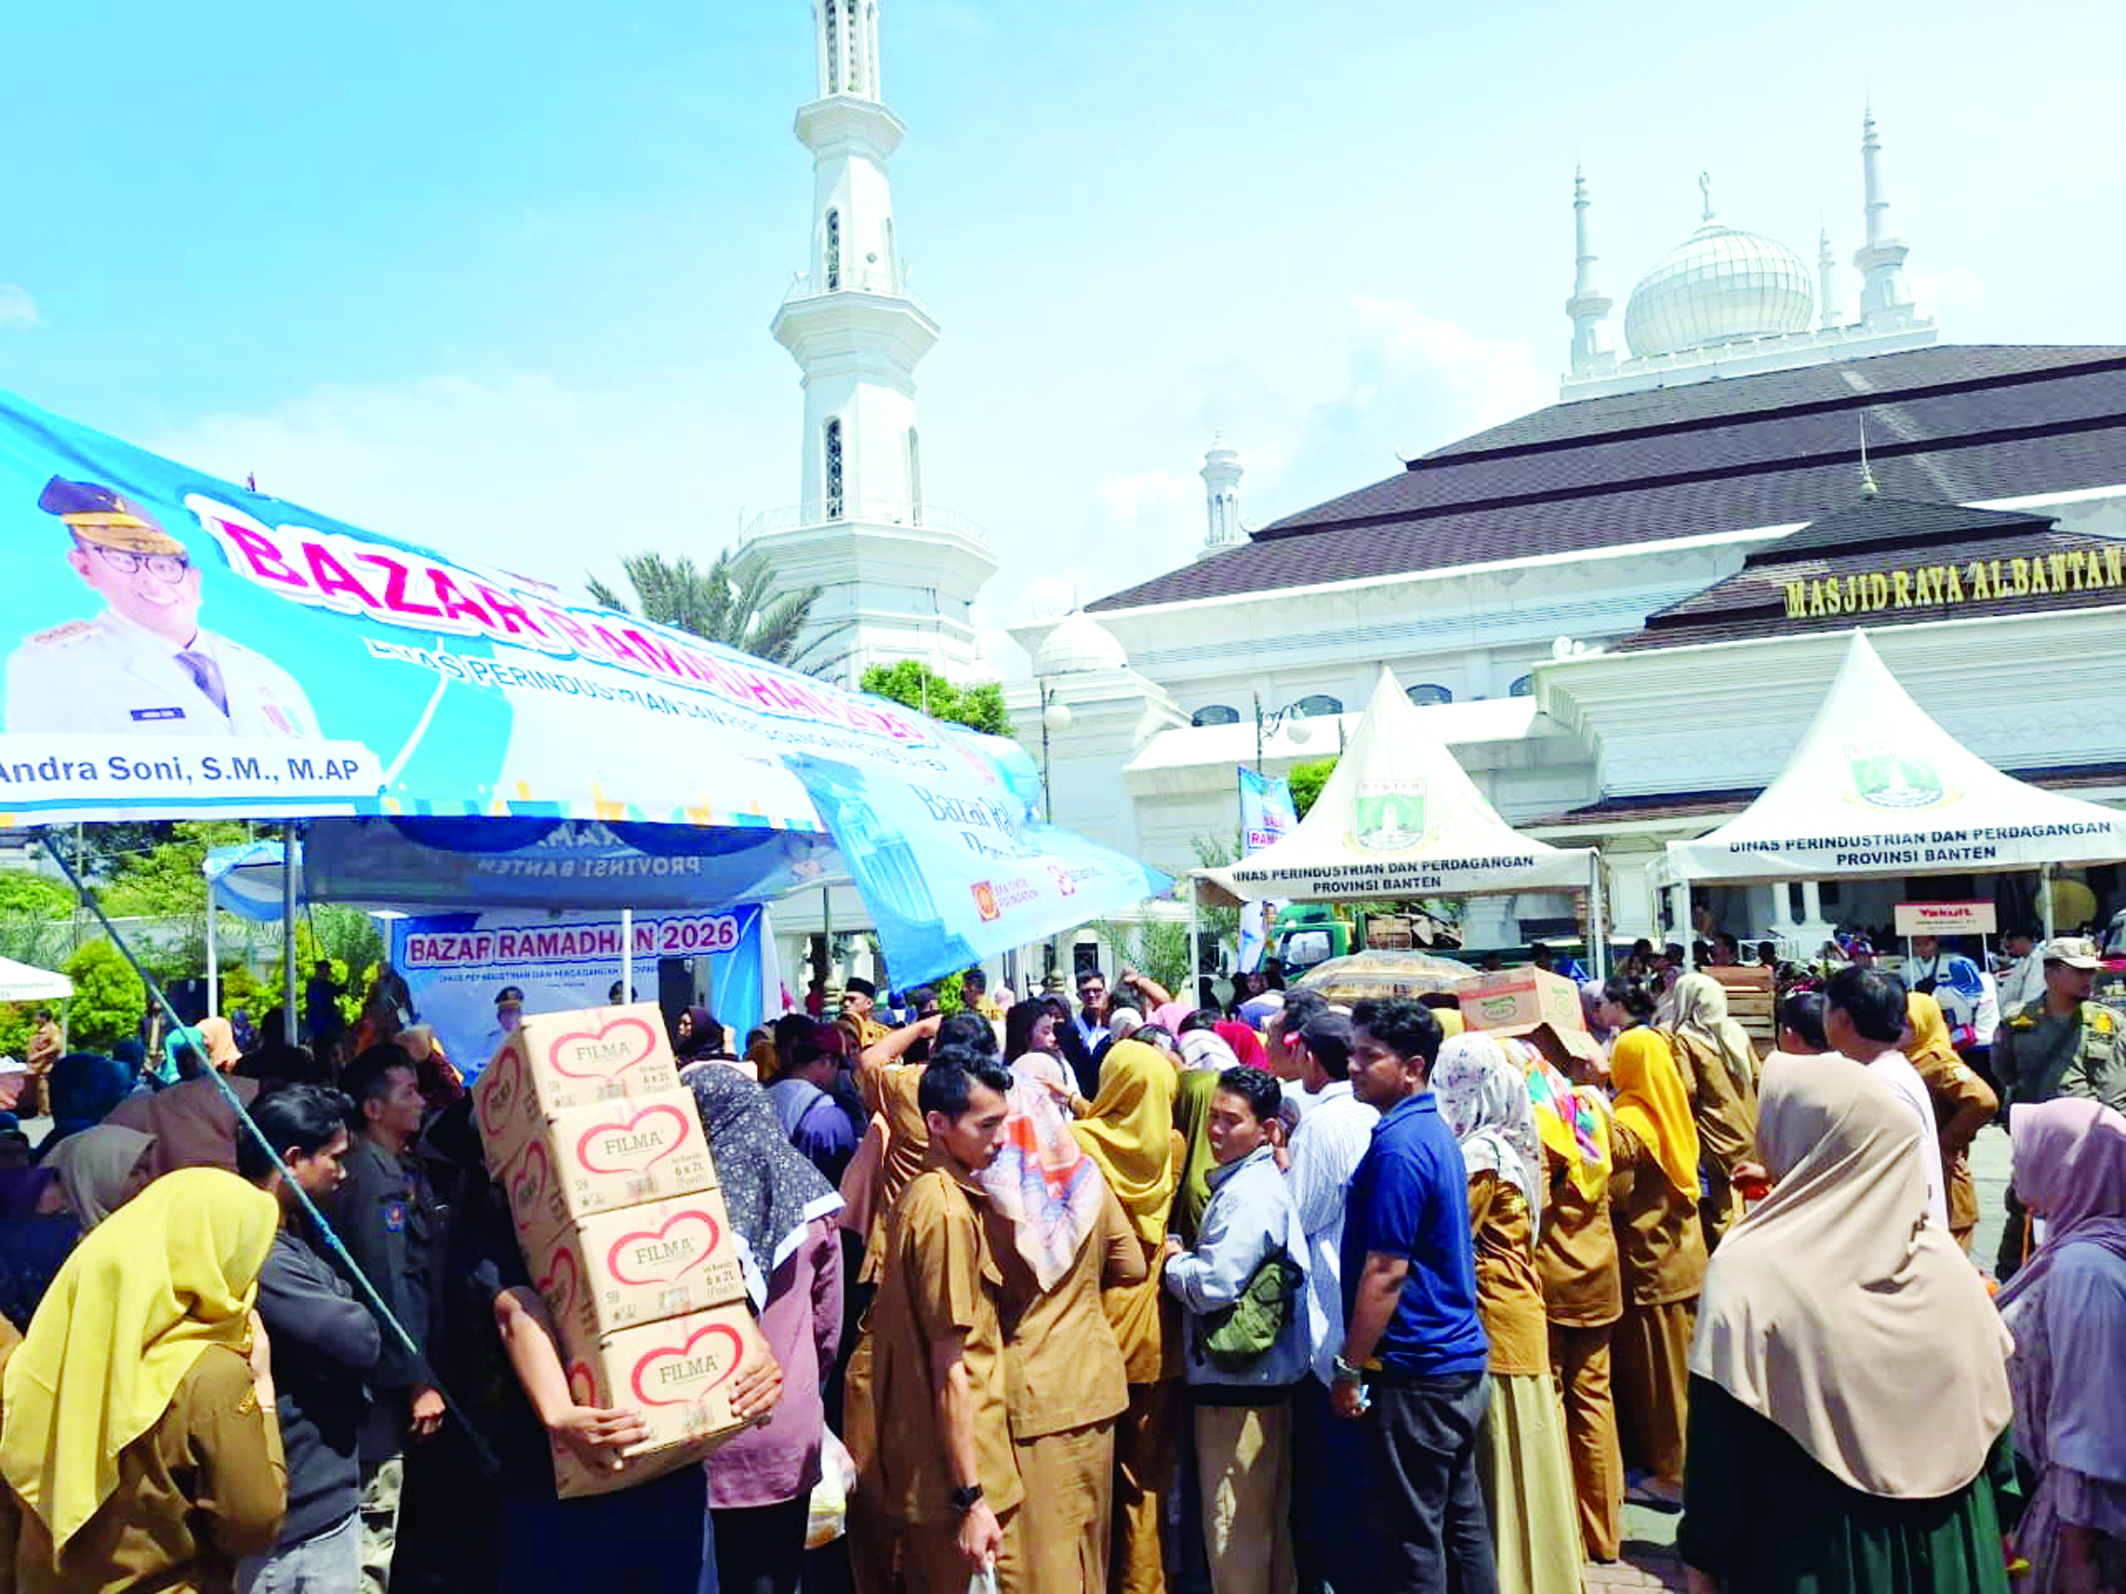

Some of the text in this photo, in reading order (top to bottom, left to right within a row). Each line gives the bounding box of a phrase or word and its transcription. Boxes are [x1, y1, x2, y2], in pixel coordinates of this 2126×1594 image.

[211, 516, 547, 638] BAZAR
[1785, 575, 1888, 617] MASJID
[1892, 564, 1963, 607] RAYA
[0, 755, 359, 784] Andra Soni, S.M., M.AP
[1730, 821, 2112, 853] DINAS PERINDUSTRIAN DAN PERDAGANGAN
[1272, 862, 1384, 881] PERINDUSTRIAN
[1388, 861, 1418, 874] DAN
[1421, 855, 1535, 872] PERDAGANGAN
[1836, 846, 1997, 867] PROVINSI BANTEN
[1313, 876, 1442, 894] PROVINSI BANTEN
[1919, 908, 1972, 917] Yakult
[410, 937, 491, 962] BAZAR
[663, 921, 734, 949] 2026
[575, 1042, 630, 1060] FILMA
[605, 1132, 663, 1154] FILMA
[636, 1238, 694, 1264] FILMA
[660, 1355, 718, 1383] FILMA
